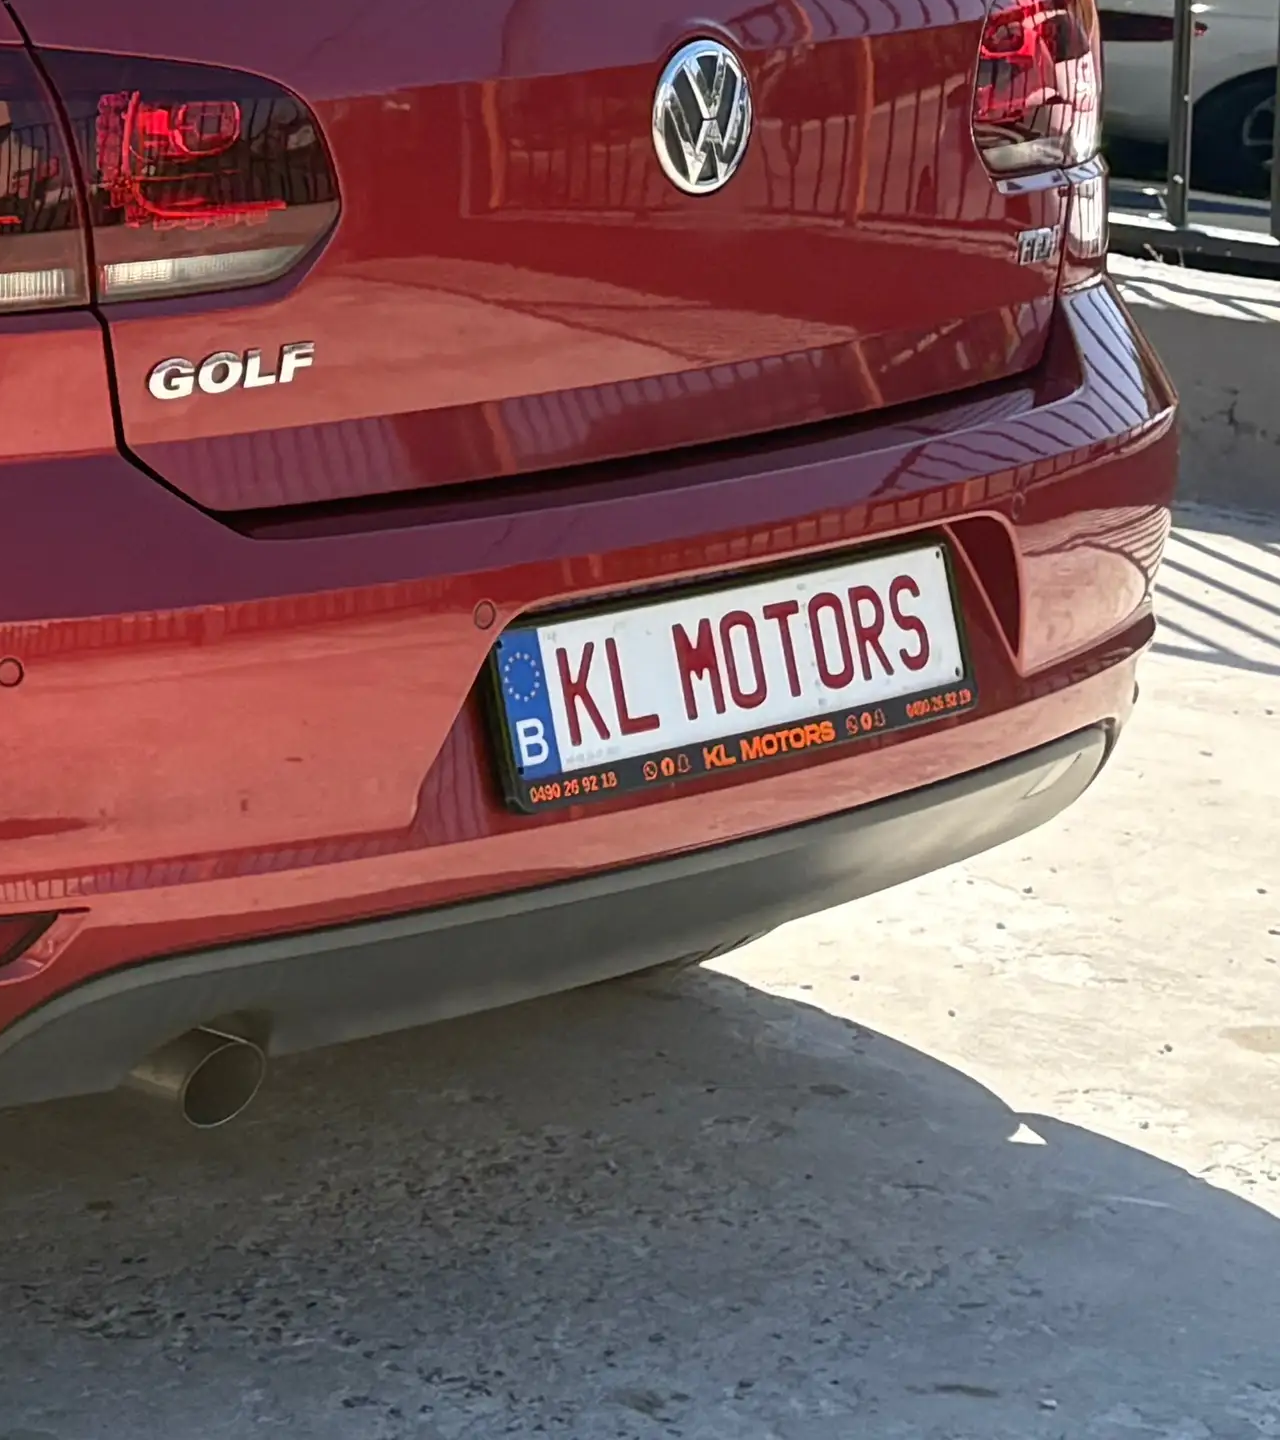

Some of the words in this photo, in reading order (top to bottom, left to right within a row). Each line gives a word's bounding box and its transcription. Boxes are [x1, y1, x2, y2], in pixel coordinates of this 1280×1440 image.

[146, 341, 316, 400] GOLF
[556, 637, 660, 746] KL
[671, 575, 930, 720] MOTORS
[516, 718, 549, 767] B
[703, 744, 737, 770] KL
[740, 720, 836, 762] MOTORS
[529, 783, 561, 804] 0490
[582, 775, 599, 794] 92
